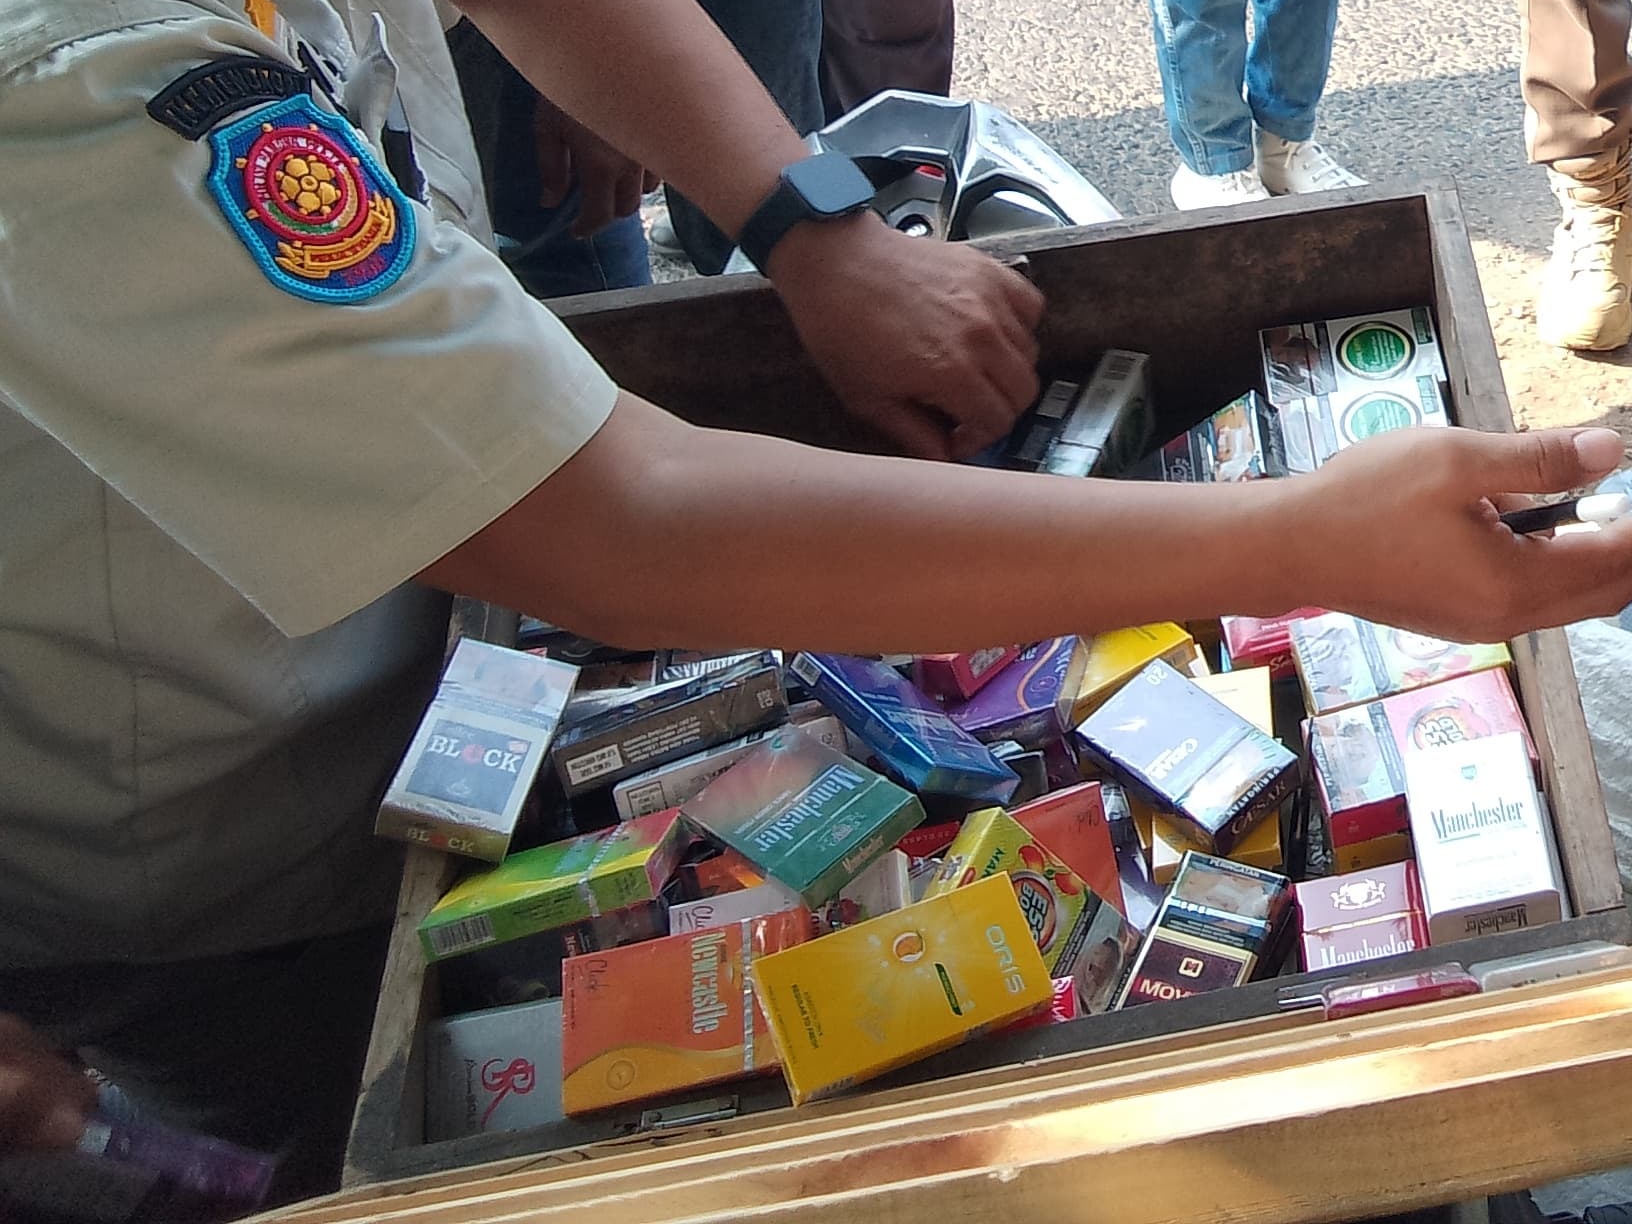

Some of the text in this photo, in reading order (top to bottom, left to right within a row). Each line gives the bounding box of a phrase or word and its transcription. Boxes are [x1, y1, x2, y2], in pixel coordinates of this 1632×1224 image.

[753, 767, 865, 851] Manchester
[1430, 798, 1524, 839] Manchester
[1465, 906, 1528, 935] Manchester
[691, 932, 728, 1034] Newcastle
[986, 924, 1025, 994] ORIS
